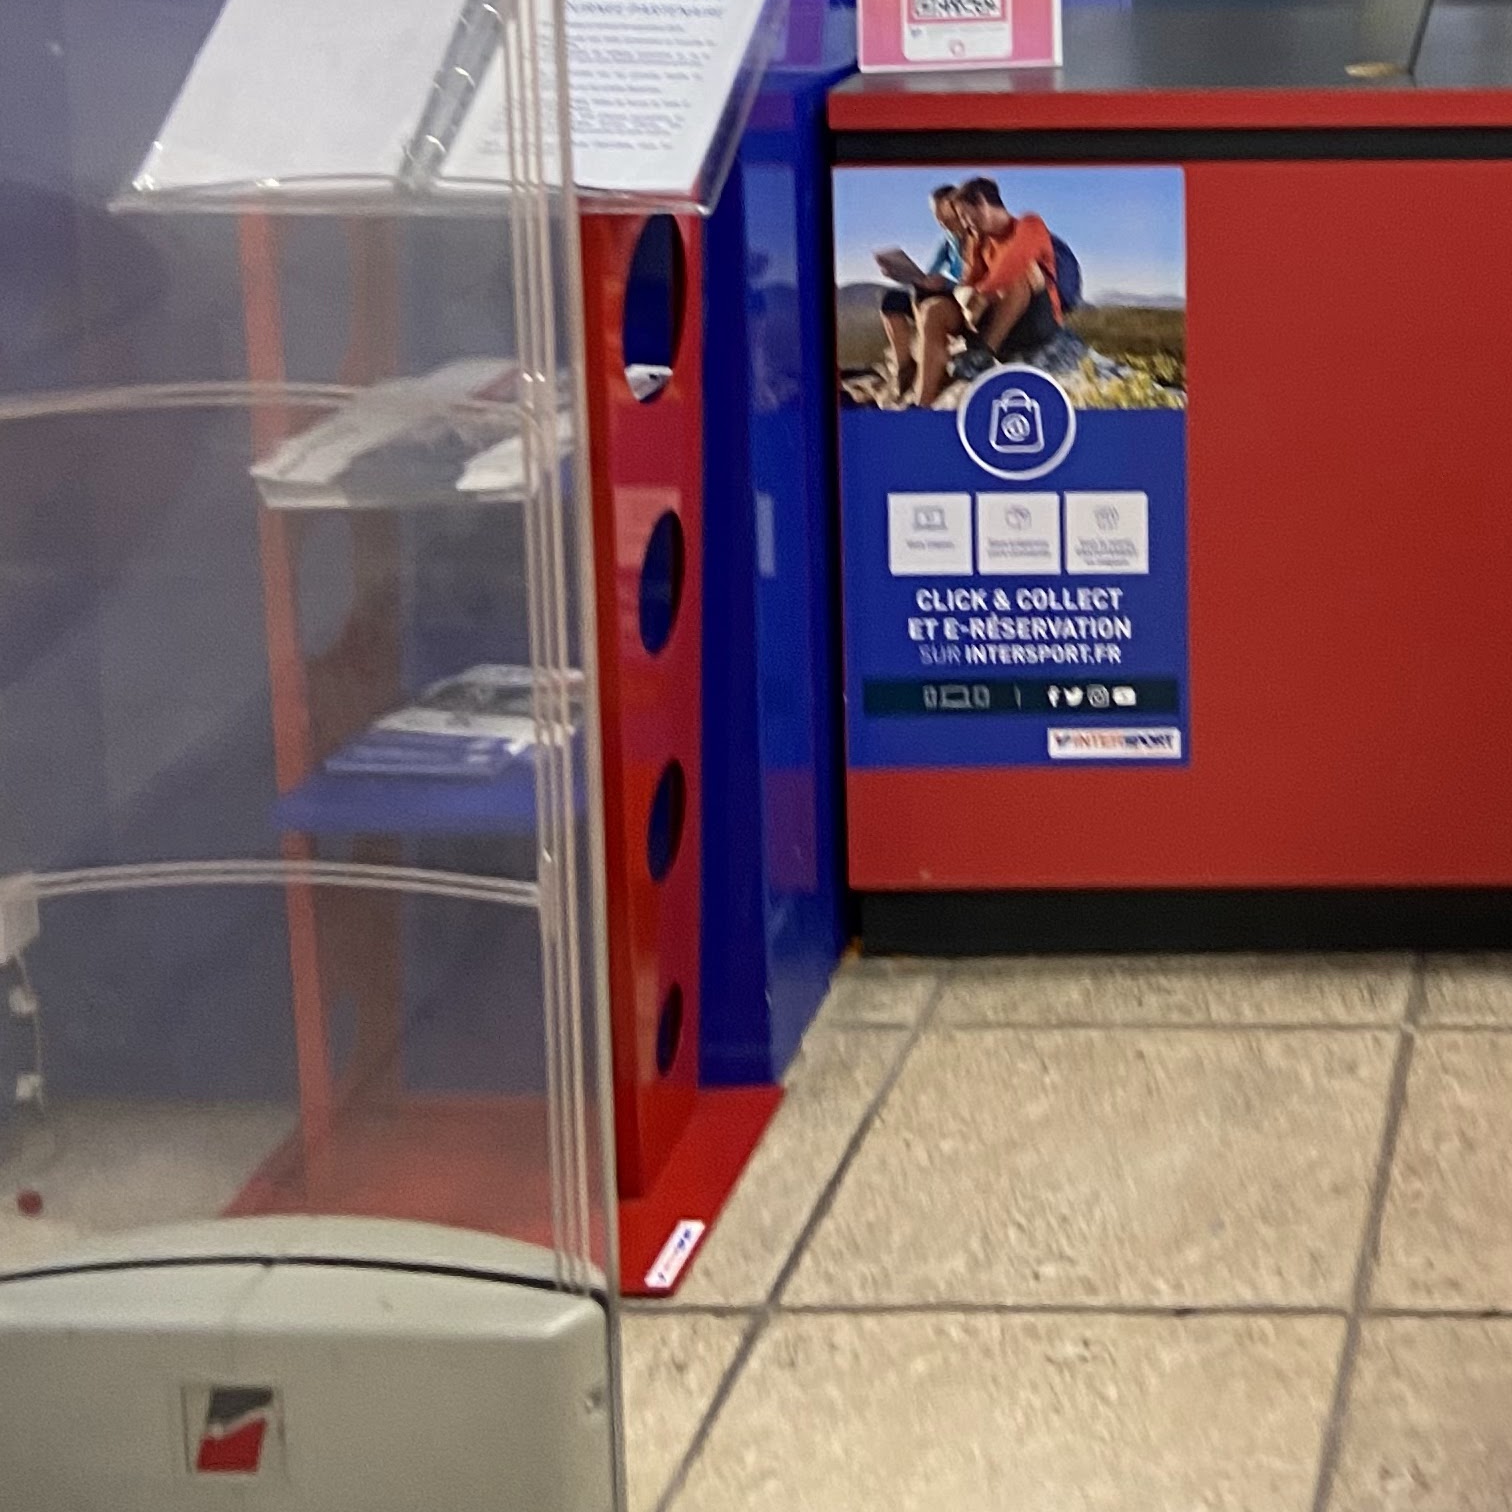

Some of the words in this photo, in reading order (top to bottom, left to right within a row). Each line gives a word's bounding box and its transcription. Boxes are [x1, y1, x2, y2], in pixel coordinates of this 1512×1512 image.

[915, 587, 988, 612] CLICK
[993, 587, 1011, 612] &
[1016, 587, 1124, 612] COLLECT
[908, 616, 938, 640] ET
[919, 644, 962, 665] SUR
[964, 643, 1122, 665] INTERSPORT.FR
